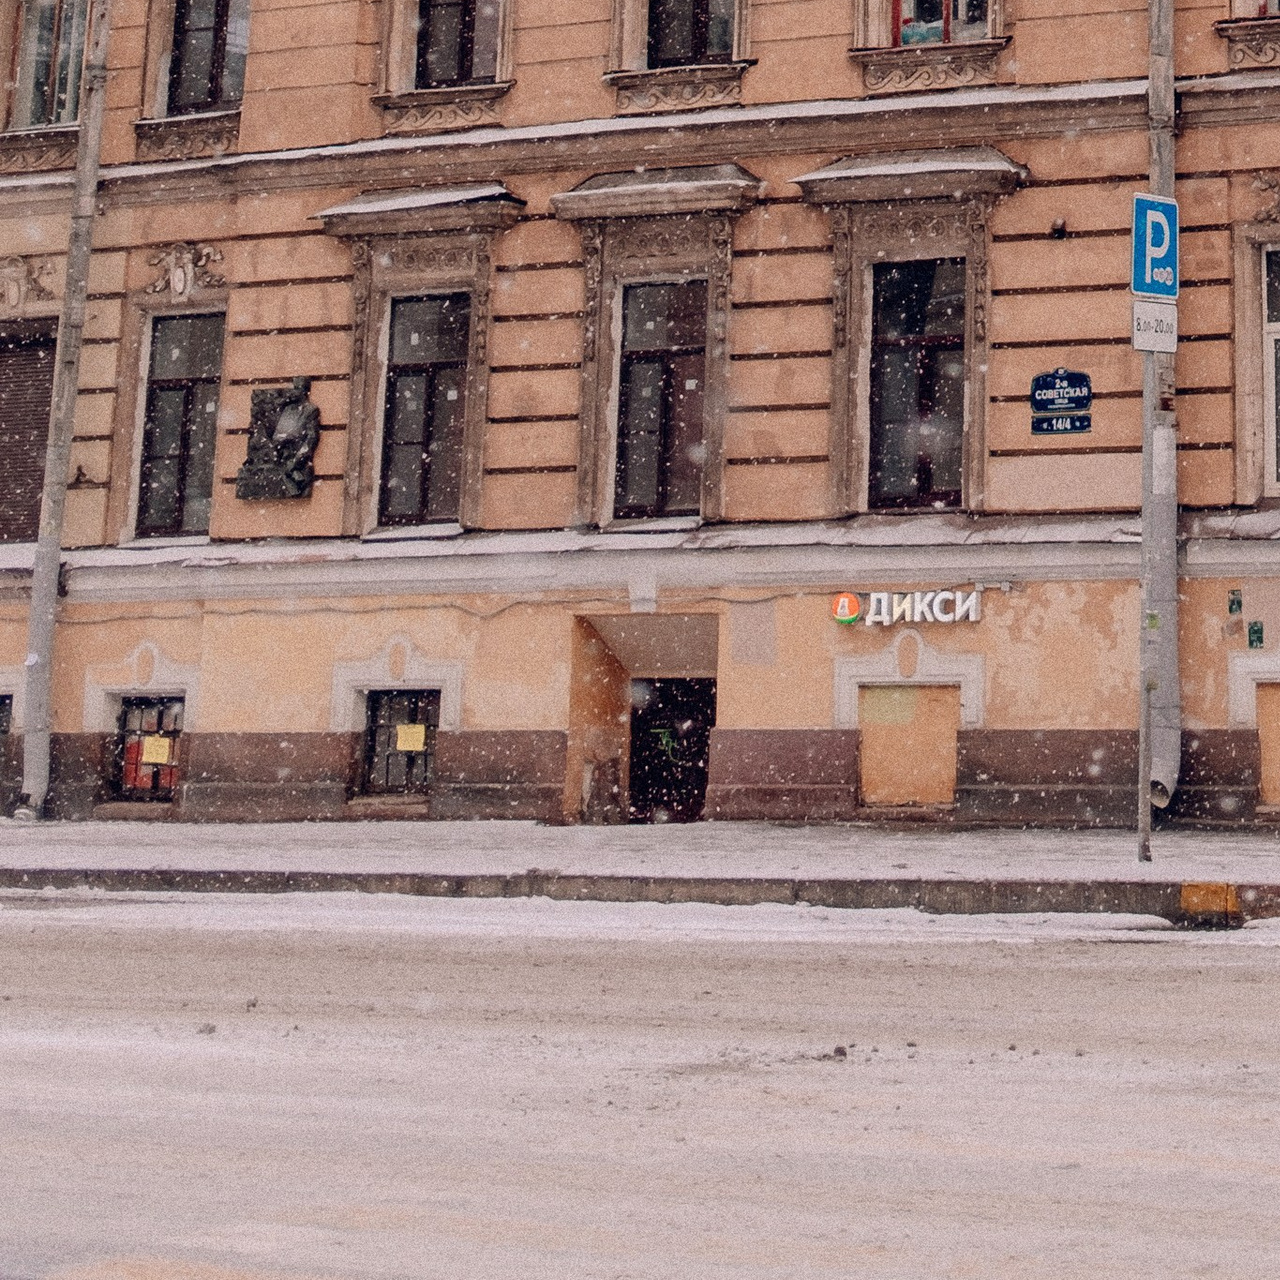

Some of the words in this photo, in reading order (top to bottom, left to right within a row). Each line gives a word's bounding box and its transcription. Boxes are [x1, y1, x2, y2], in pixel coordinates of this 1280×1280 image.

[1145, 209, 1170, 285] P
[1035, 387, 1088, 400] СОВЕТСКАЯ
[1051, 417, 1071, 430] 14/4
[865, 591, 979, 626] ДИКСИ
